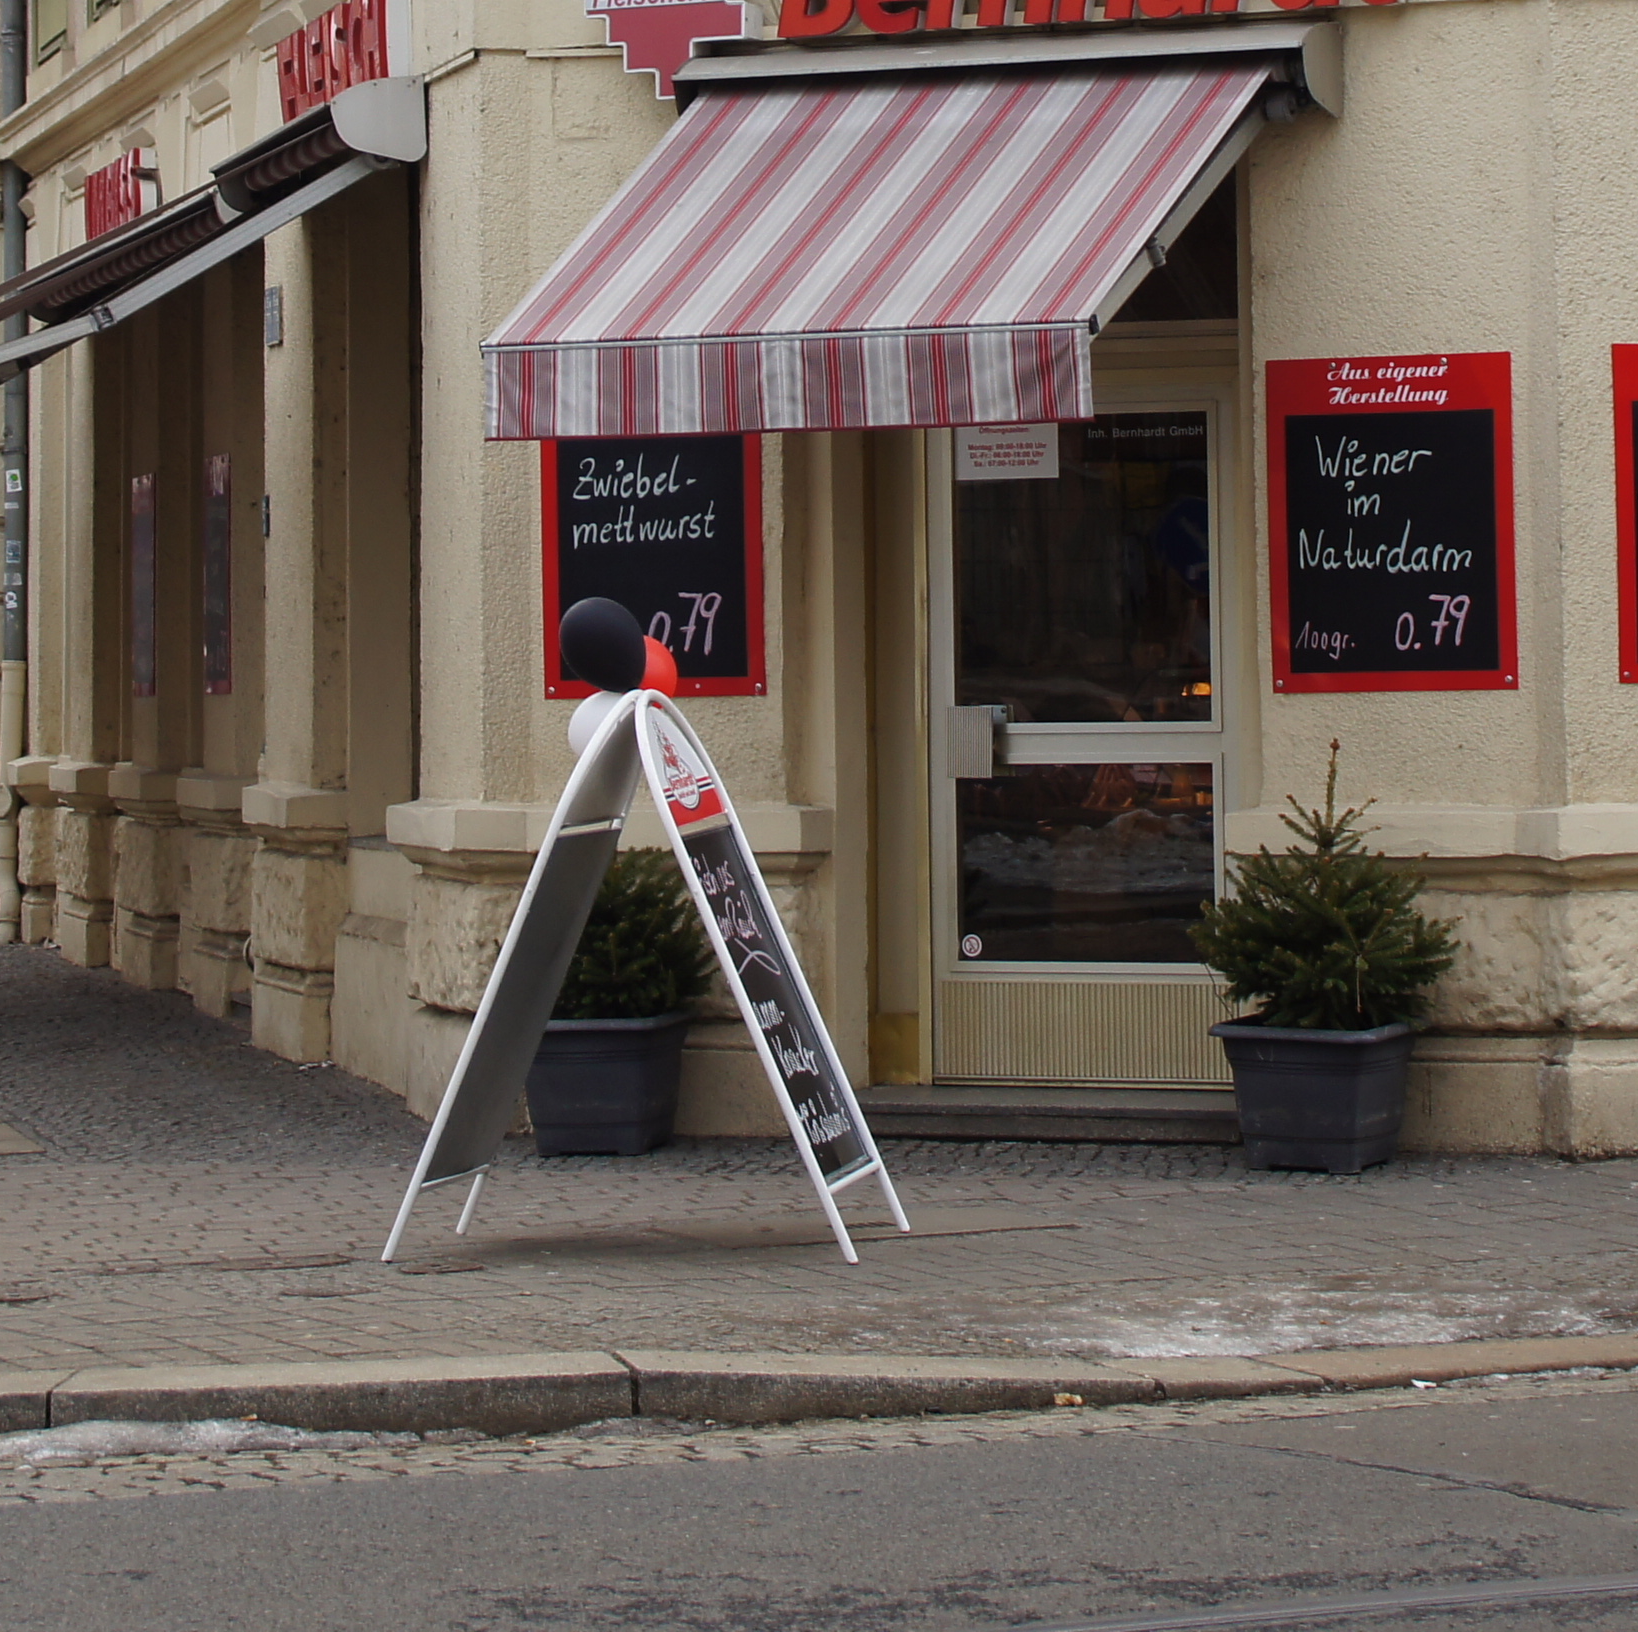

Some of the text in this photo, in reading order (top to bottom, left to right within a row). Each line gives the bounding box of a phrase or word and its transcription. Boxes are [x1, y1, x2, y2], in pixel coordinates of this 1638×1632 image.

[1326, 359, 1449, 383] Aus eigener
[1328, 385, 1449, 406] Herstellung
[1087, 423, 1204, 439] Inh. Bernhardt GmbH
[571, 454, 698, 502] Zwiebel-
[1314, 434, 1433, 479] Wiener
[1344, 479, 1381, 517] im
[571, 499, 717, 550] mettwurst
[1298, 519, 1474, 575] Naturdarm
[1394, 593, 1471, 651] 0.79
